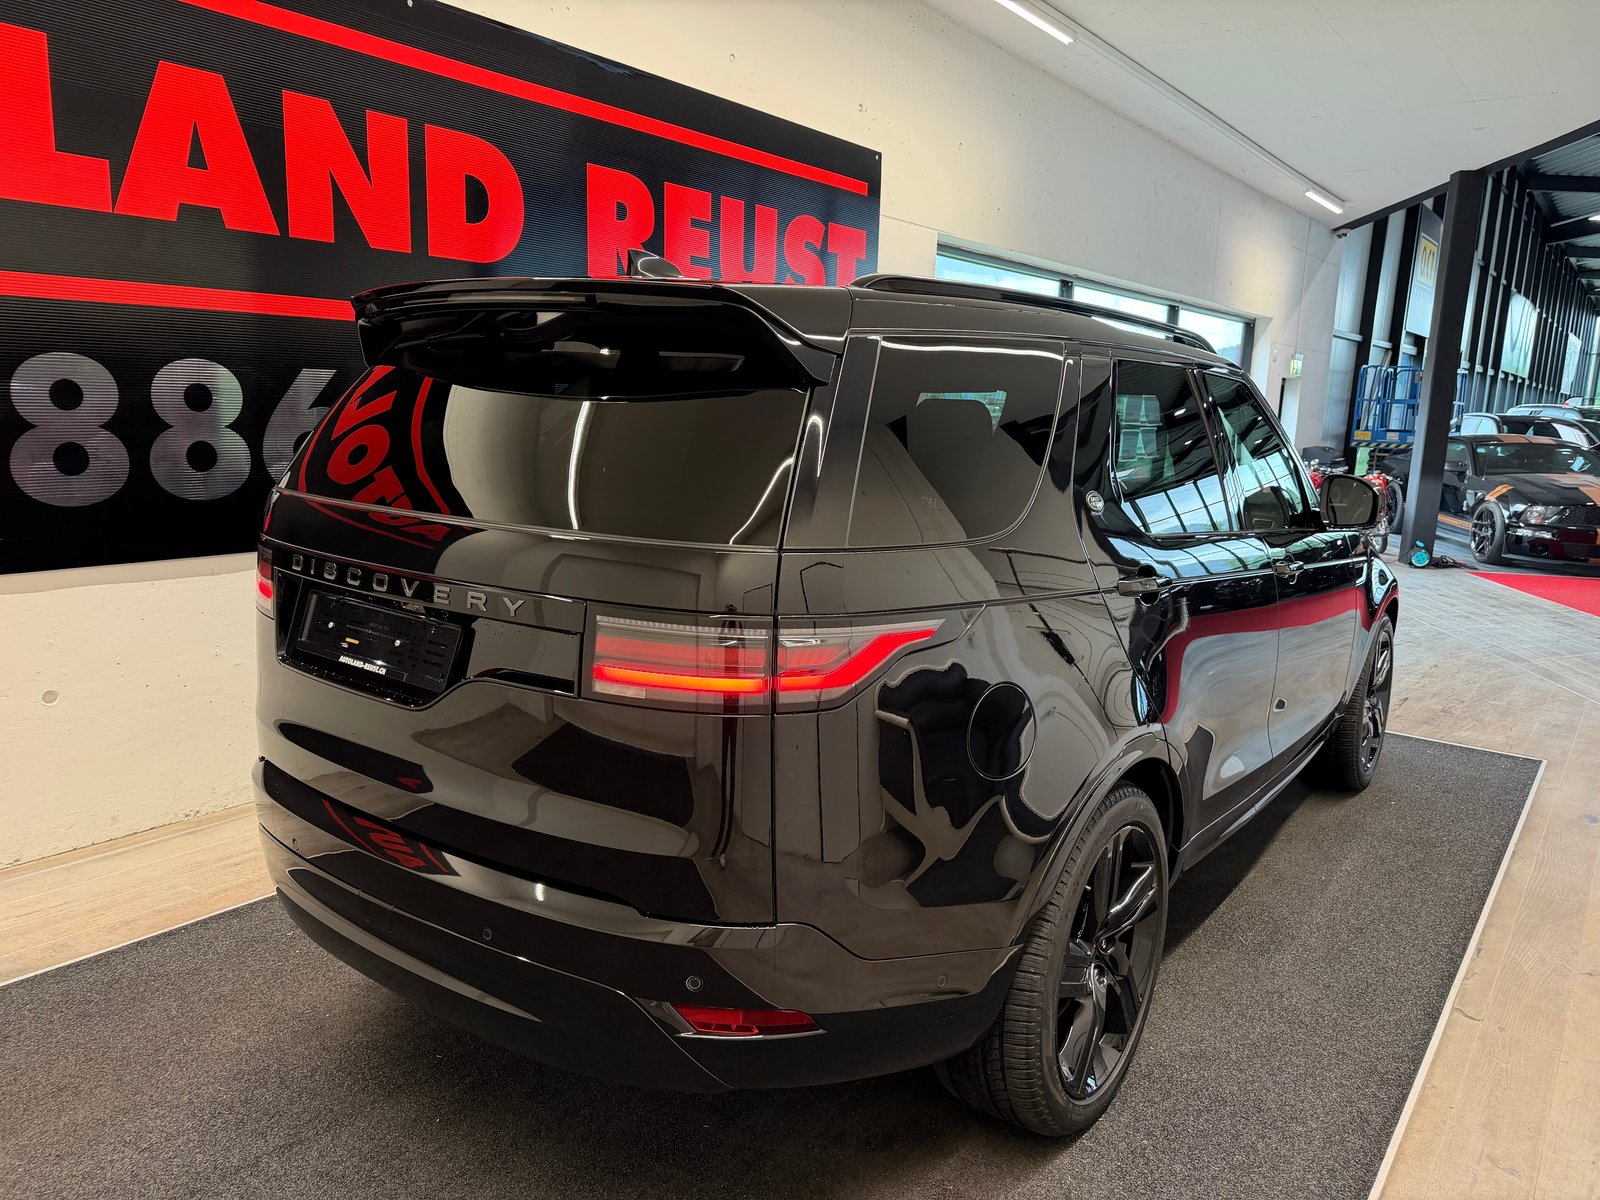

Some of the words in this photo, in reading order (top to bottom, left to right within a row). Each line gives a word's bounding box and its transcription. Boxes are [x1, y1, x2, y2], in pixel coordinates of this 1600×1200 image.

[0, 21, 525, 264] LAND
[586, 162, 867, 288] REUST
[291, 554, 526, 617] DISCOVERY
[338, 655, 387, 675] AUTOLAND-REUST.CH
